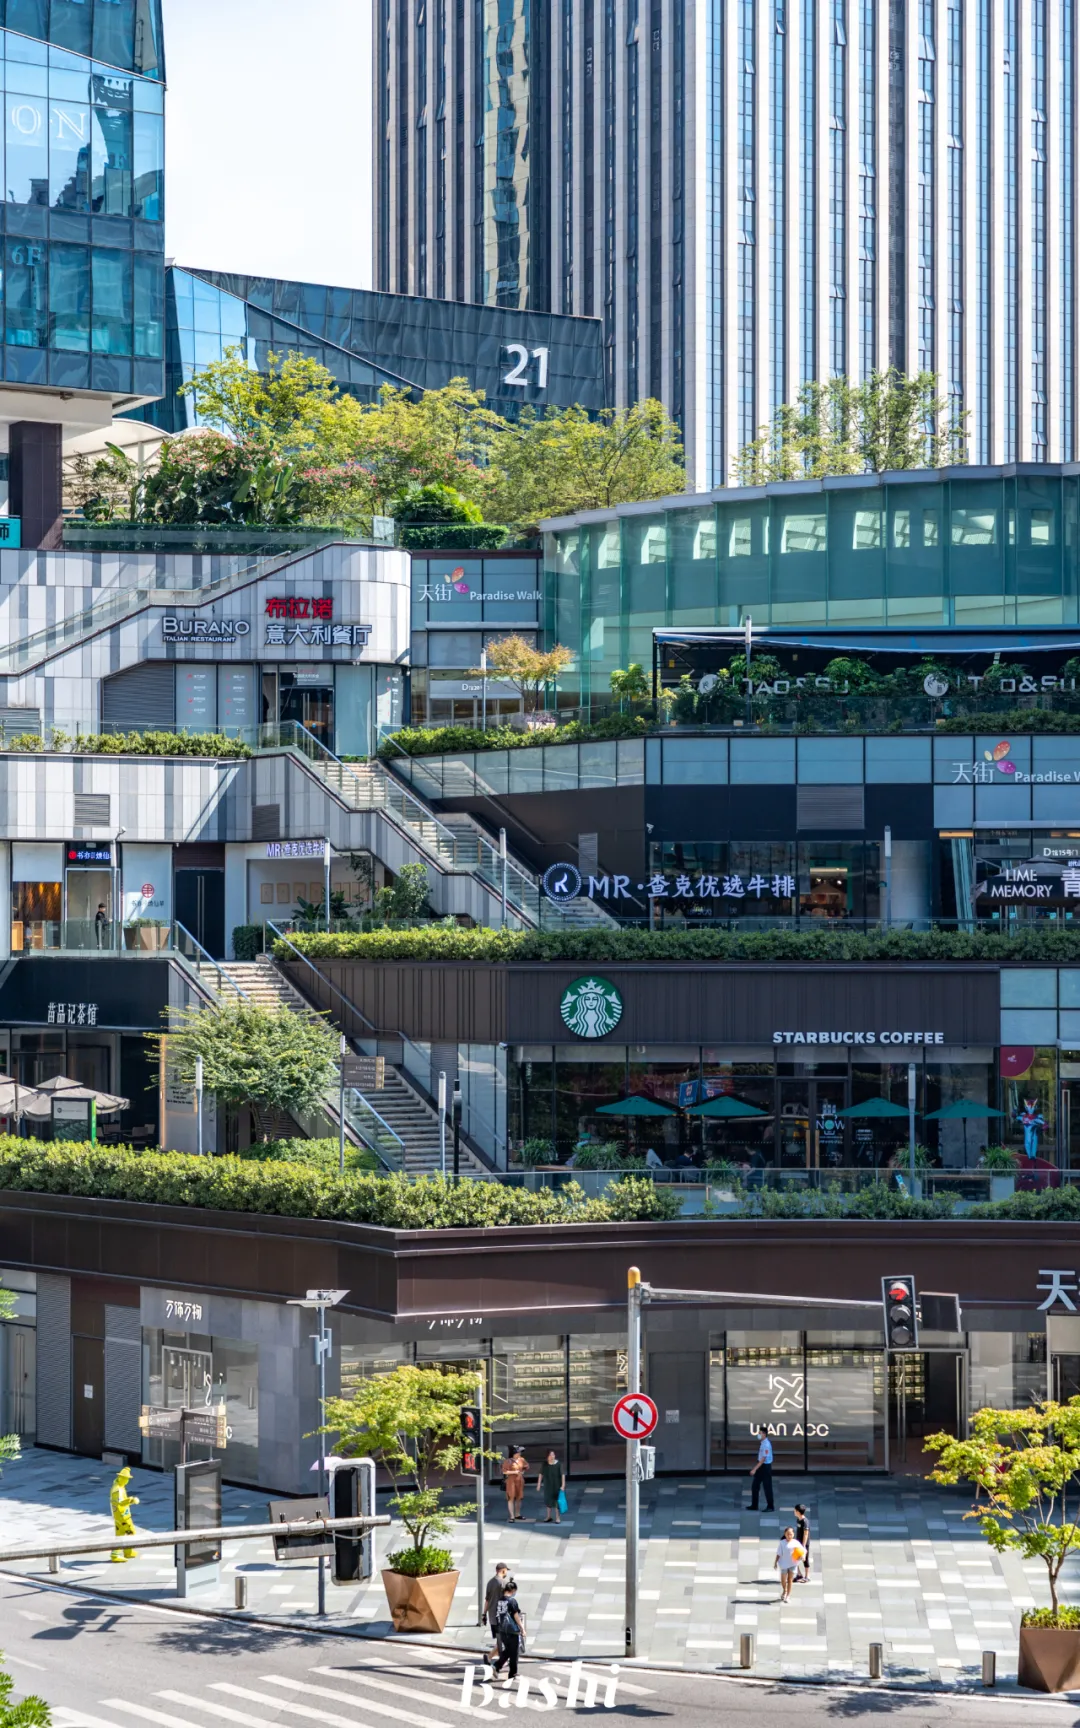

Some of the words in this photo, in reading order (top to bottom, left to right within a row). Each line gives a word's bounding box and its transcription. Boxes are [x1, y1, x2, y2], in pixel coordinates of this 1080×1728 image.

[504, 344, 548, 387] 21
[418, 583, 452, 601] 天街
[469, 591, 514, 601] Paradise
[516, 591, 543, 600] Walk
[265, 597, 333, 619] 布拉诺
[266, 624, 373, 646] 意大利餐厅
[968, 675, 1076, 693] TO&SU
[952, 762, 995, 783] 天街
[1015, 772, 1071, 783] Paradise
[1006, 869, 1038, 882] LIME
[991, 885, 1053, 897] MEMORY
[773, 1032, 876, 1044] STARBUCKS
[880, 1032, 944, 1044] COFFEE
